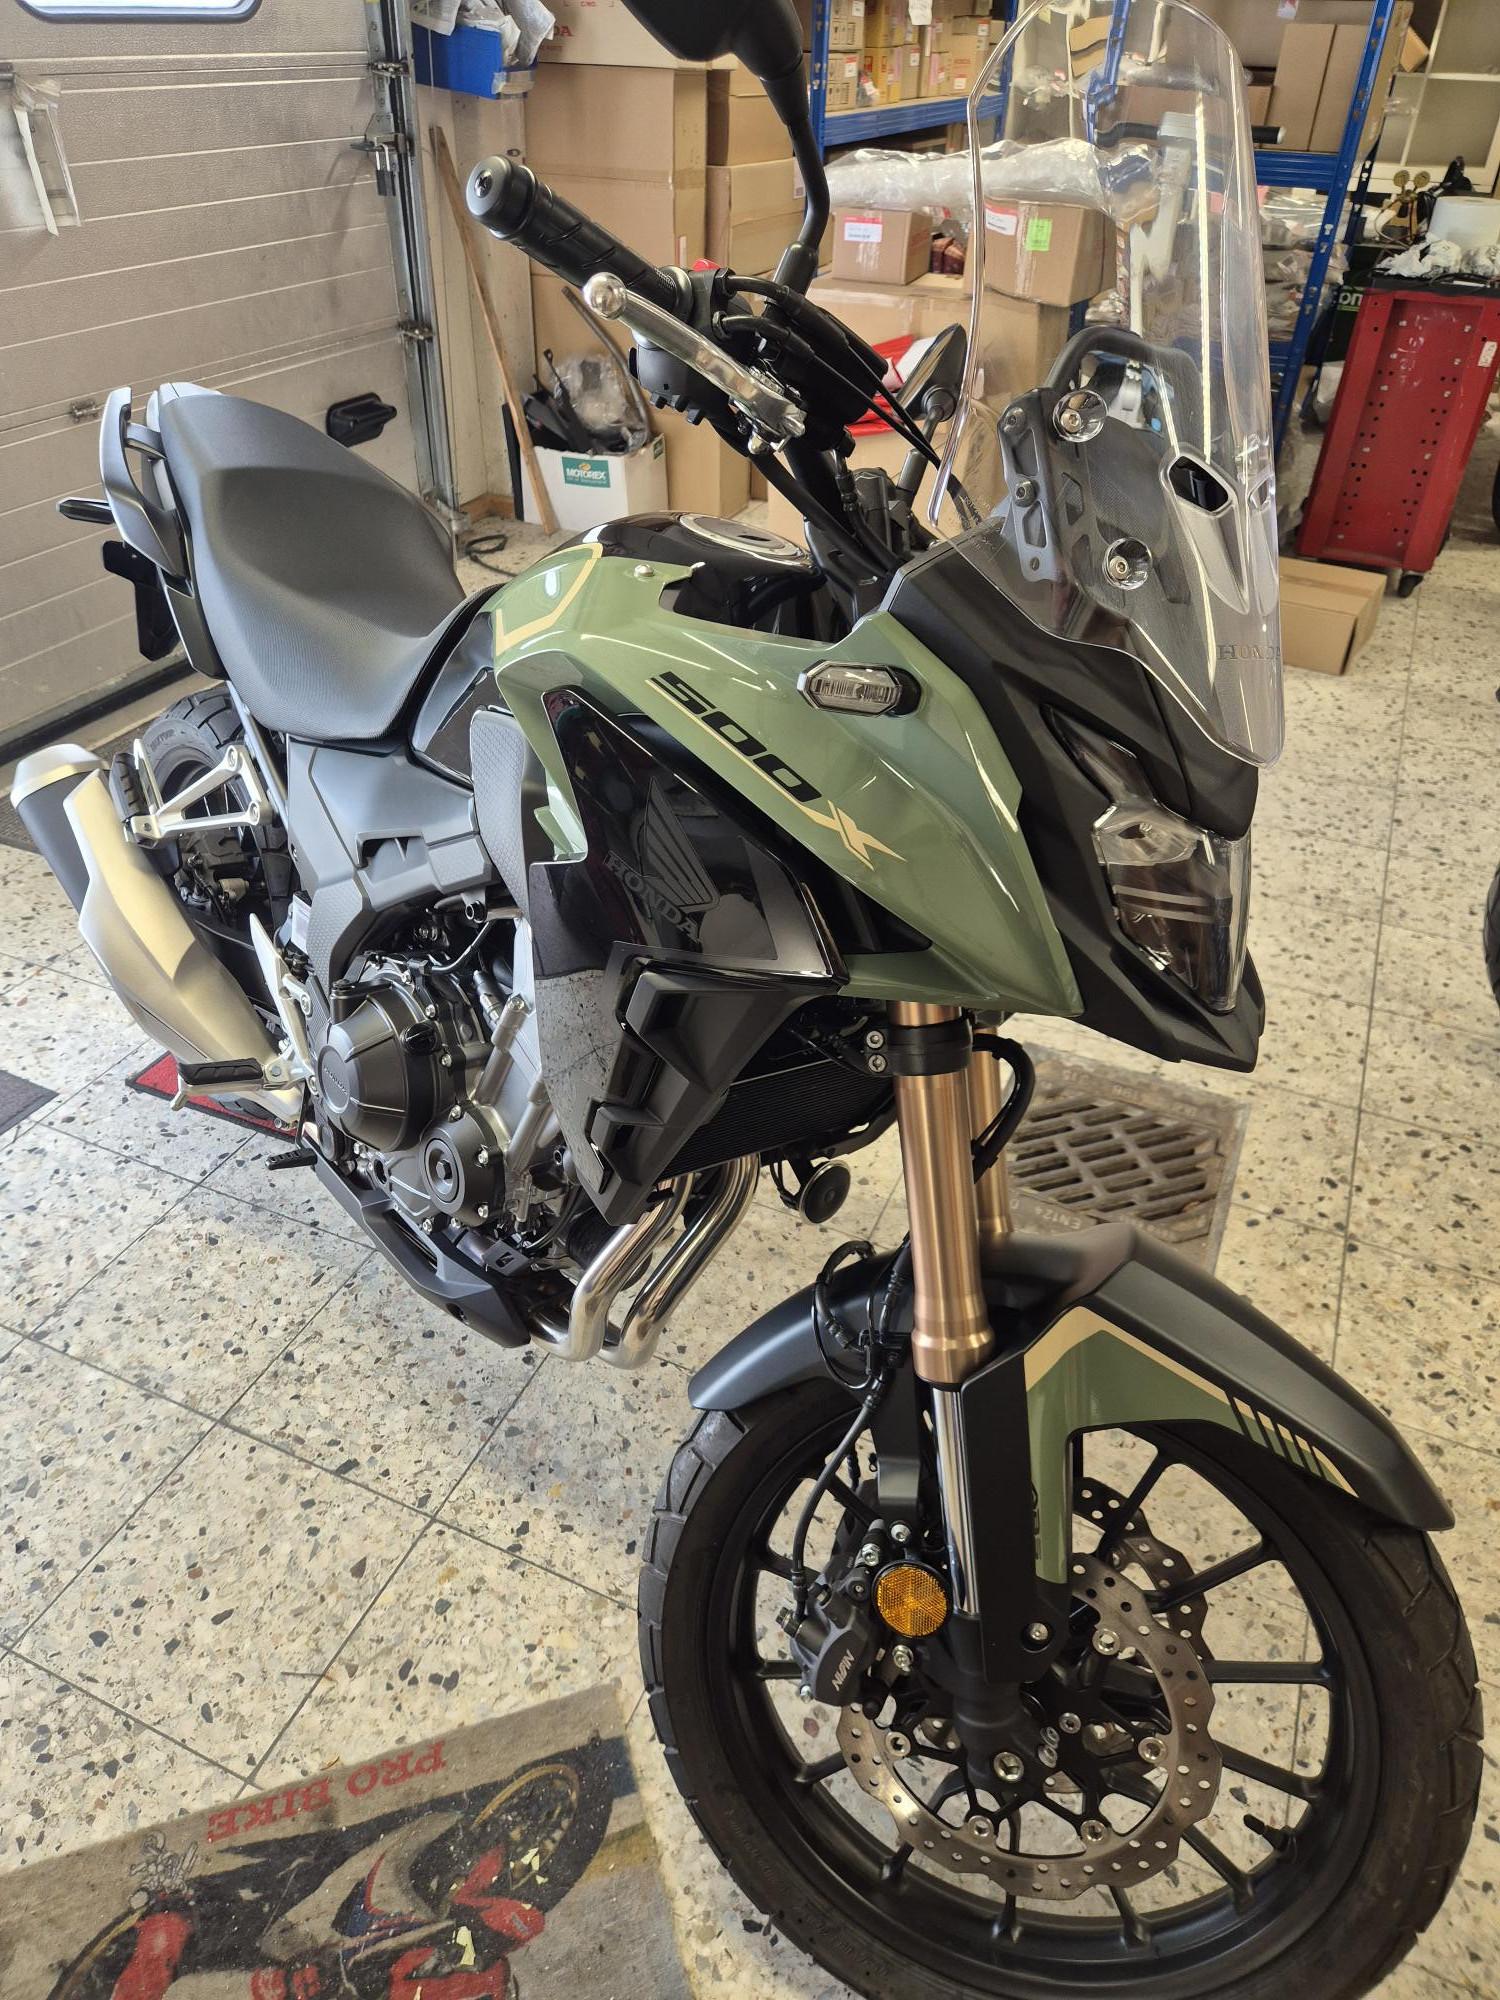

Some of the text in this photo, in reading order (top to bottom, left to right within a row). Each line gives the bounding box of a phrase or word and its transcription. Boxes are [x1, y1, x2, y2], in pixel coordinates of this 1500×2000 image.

[566, 468, 607, 480] MOTOREX
[603, 850, 699, 944] HONDA
[207, 1740, 447, 1842] PRO BIKE
